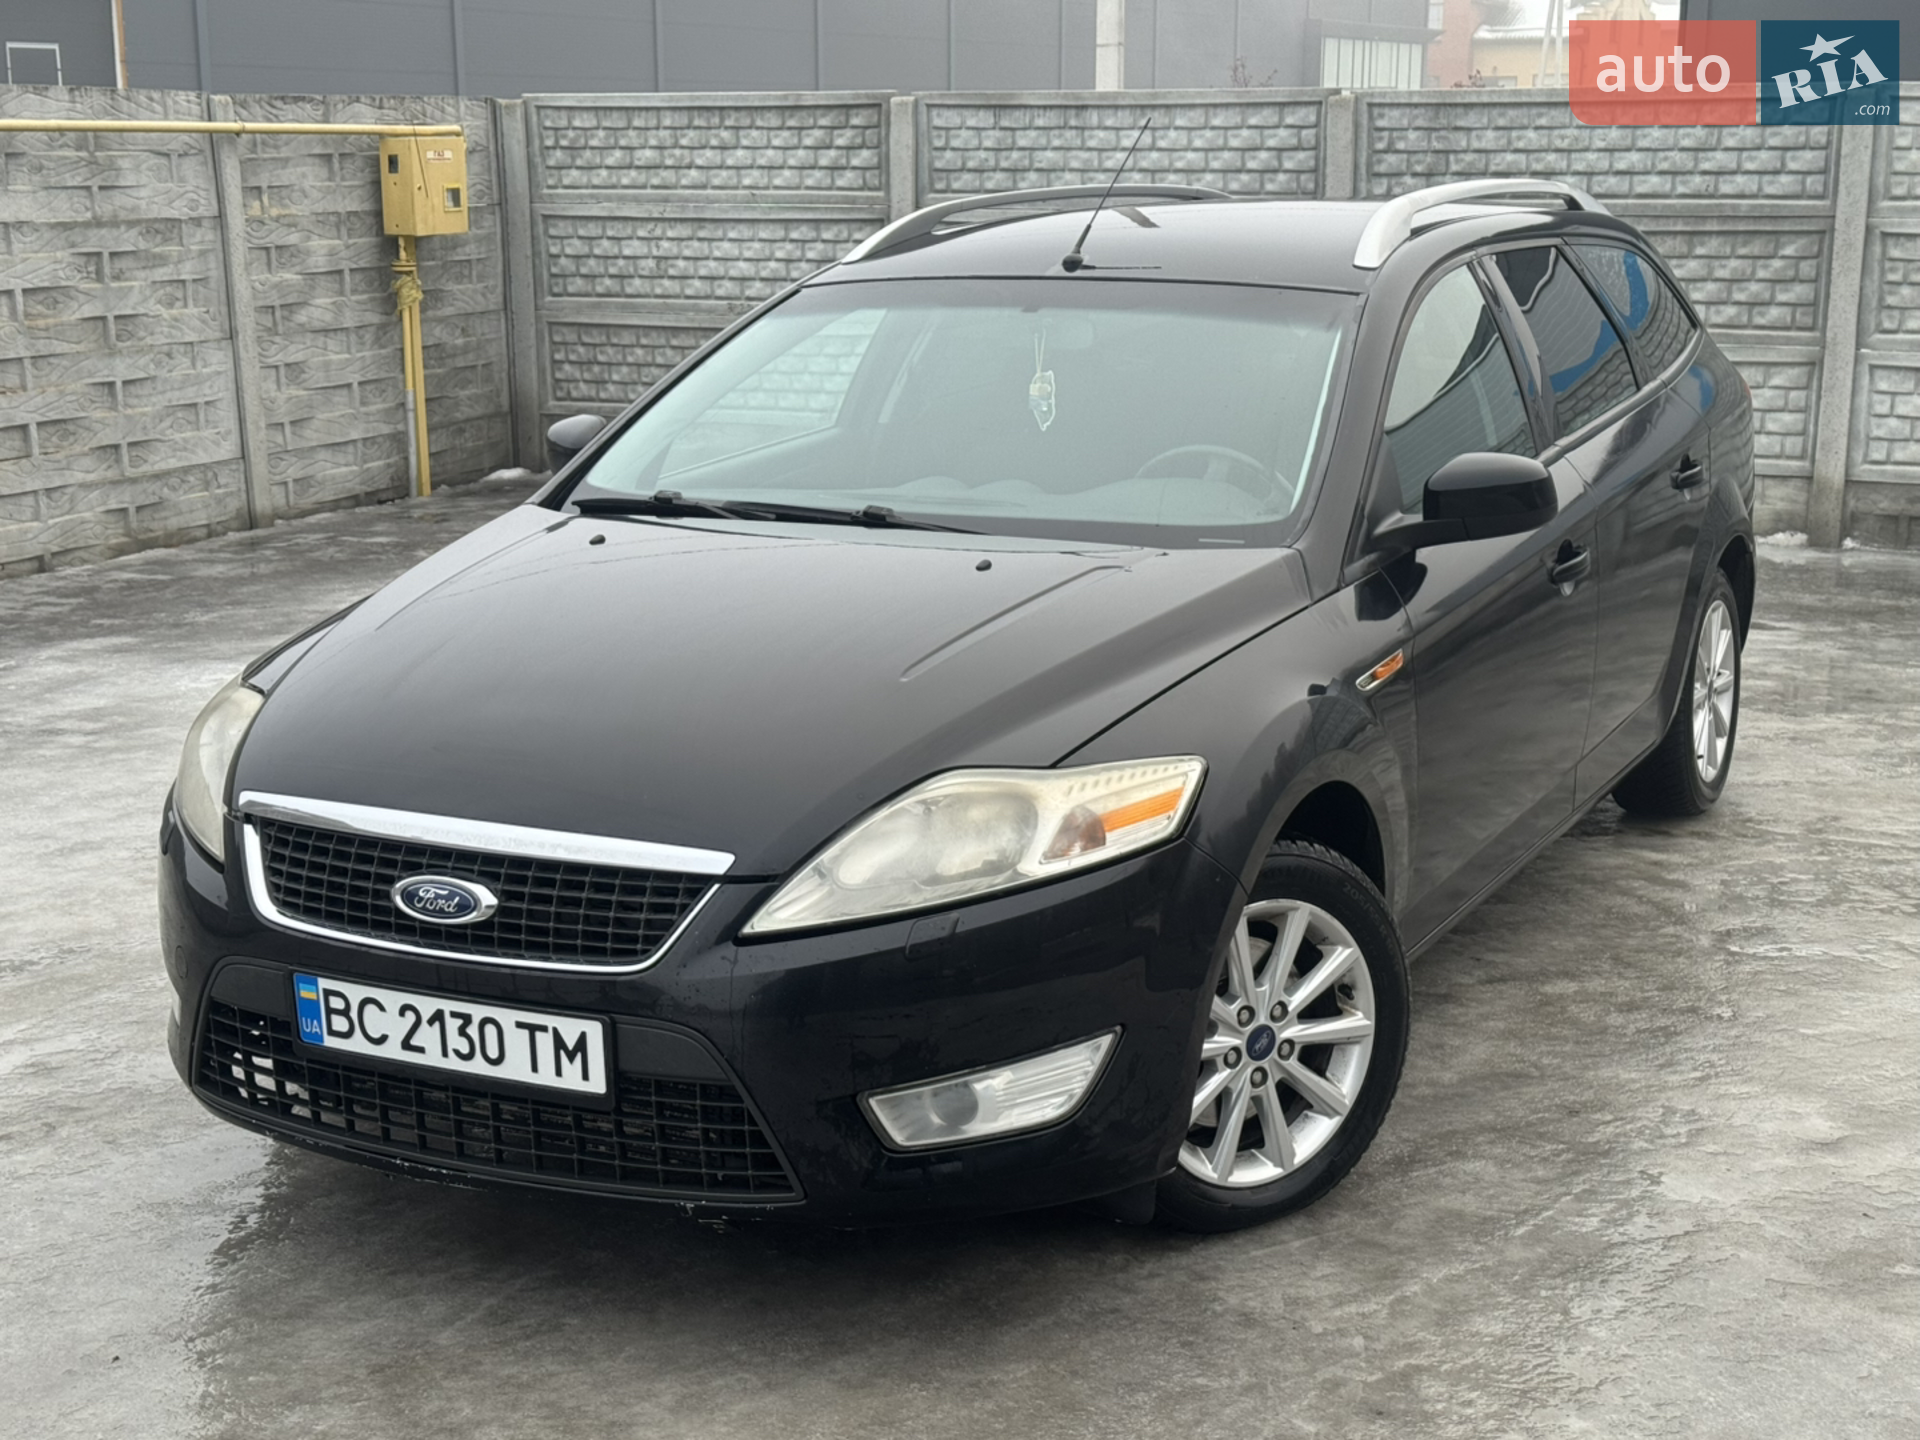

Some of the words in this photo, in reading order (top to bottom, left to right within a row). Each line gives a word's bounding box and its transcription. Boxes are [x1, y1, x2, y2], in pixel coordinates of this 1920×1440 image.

[414, 886, 460, 913] Ford
[302, 1016, 322, 1036] UA
[322, 987, 389, 1046] BC
[398, 1003, 506, 1067] 2130
[515, 1020, 590, 1082] TM
